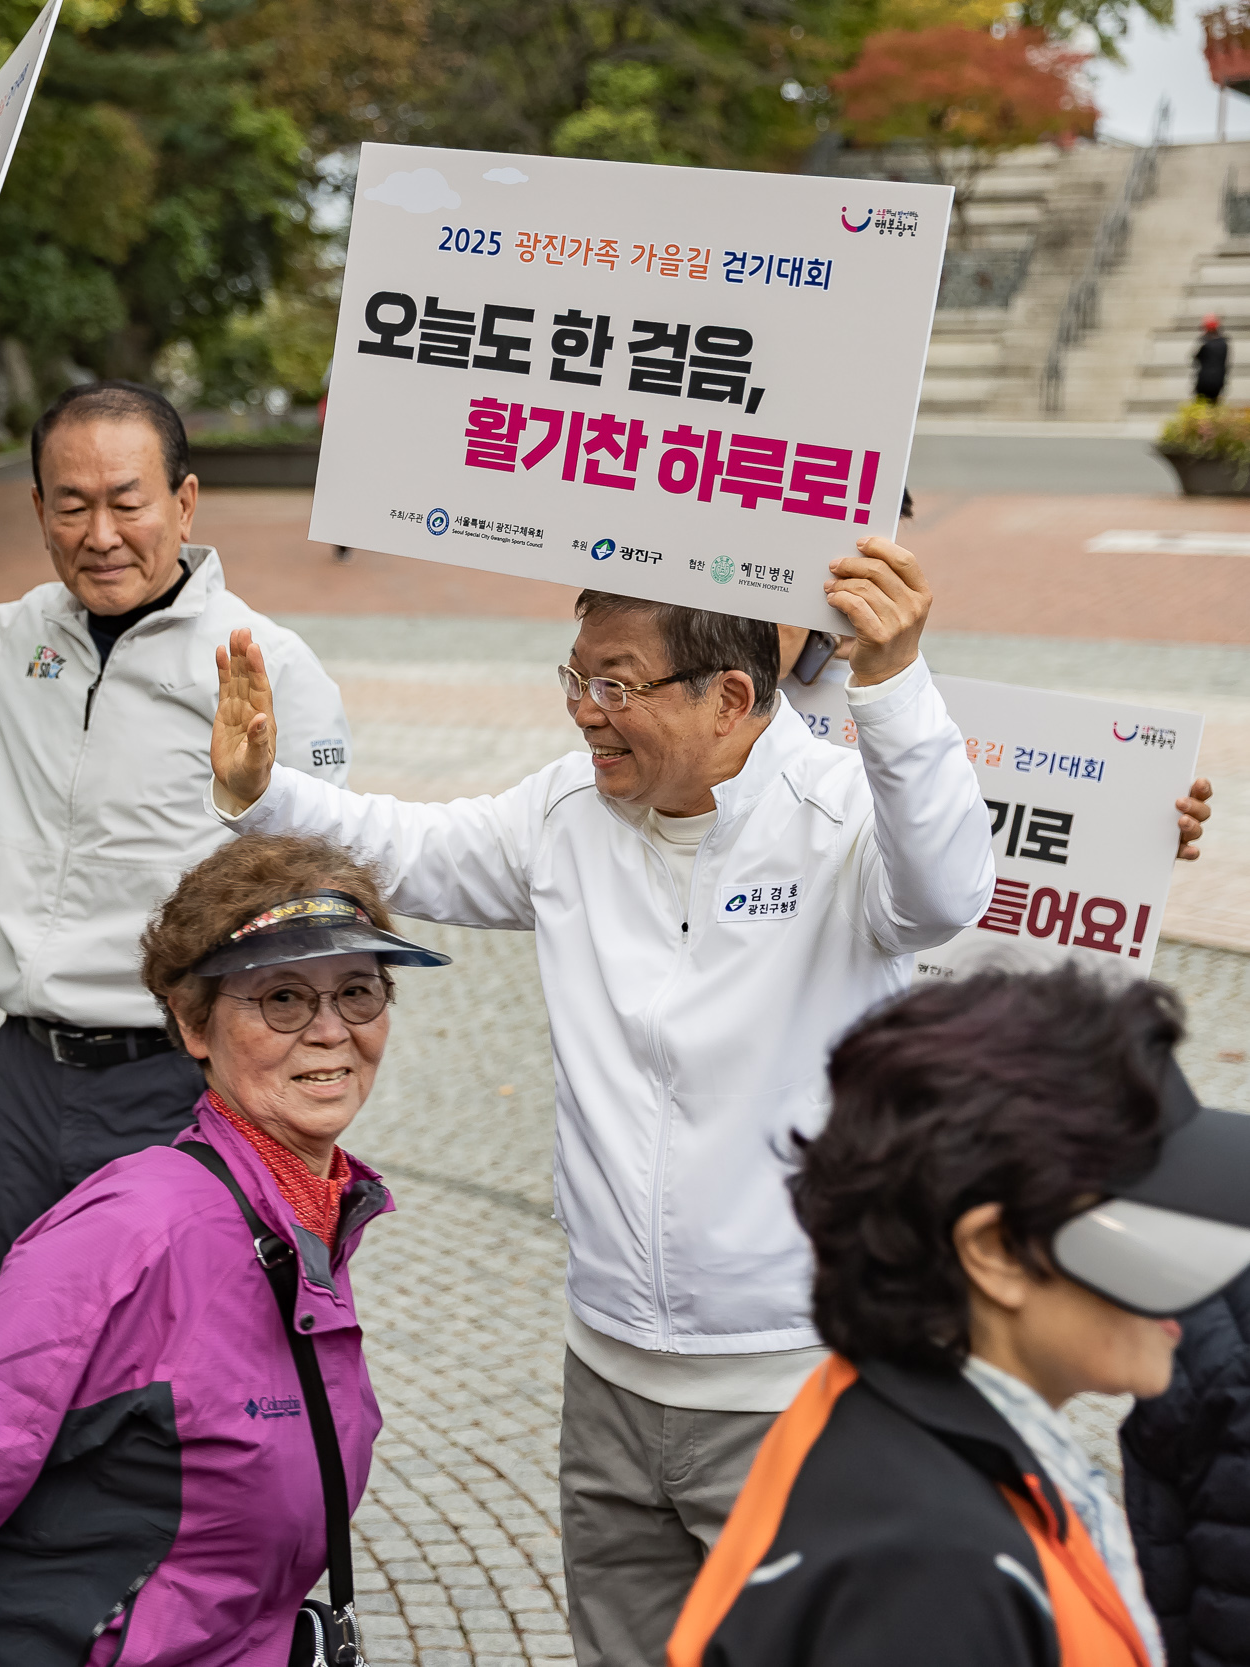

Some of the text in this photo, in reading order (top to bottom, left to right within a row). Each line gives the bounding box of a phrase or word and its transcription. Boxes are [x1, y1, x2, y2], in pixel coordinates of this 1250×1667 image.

[875, 218, 918, 237] 행복광진
[437, 225, 833, 291] 2025 광진가족 가을길 걷기대회
[357, 290, 766, 415] 오늘도 한 걸음,
[464, 396, 881, 526] 활기찬 하루로!
[389, 509, 424, 524] 주최/주관
[454, 515, 494, 531] 서울특별시
[496, 522, 544, 539] 광진구체육회
[464, 530, 481, 539] Special
[481, 533, 490, 541] City
[511, 538, 526, 546] Sports
[571, 539, 588, 551] 후원
[619, 546, 663, 565] 광진구
[688, 558, 706, 572] 협찬
[740, 562, 795, 585] 혜민병원
[738, 578, 790, 593] HYEMIN HOSPITAL
[800, 712, 831, 736] 25
[966, 737, 1005, 768] 을길
[1014, 746, 1106, 783] 걷기대회
[983, 798, 1074, 866] 기로
[748, 900, 797, 915] 광진구청장
[977, 876, 1152, 960] 들어요!
